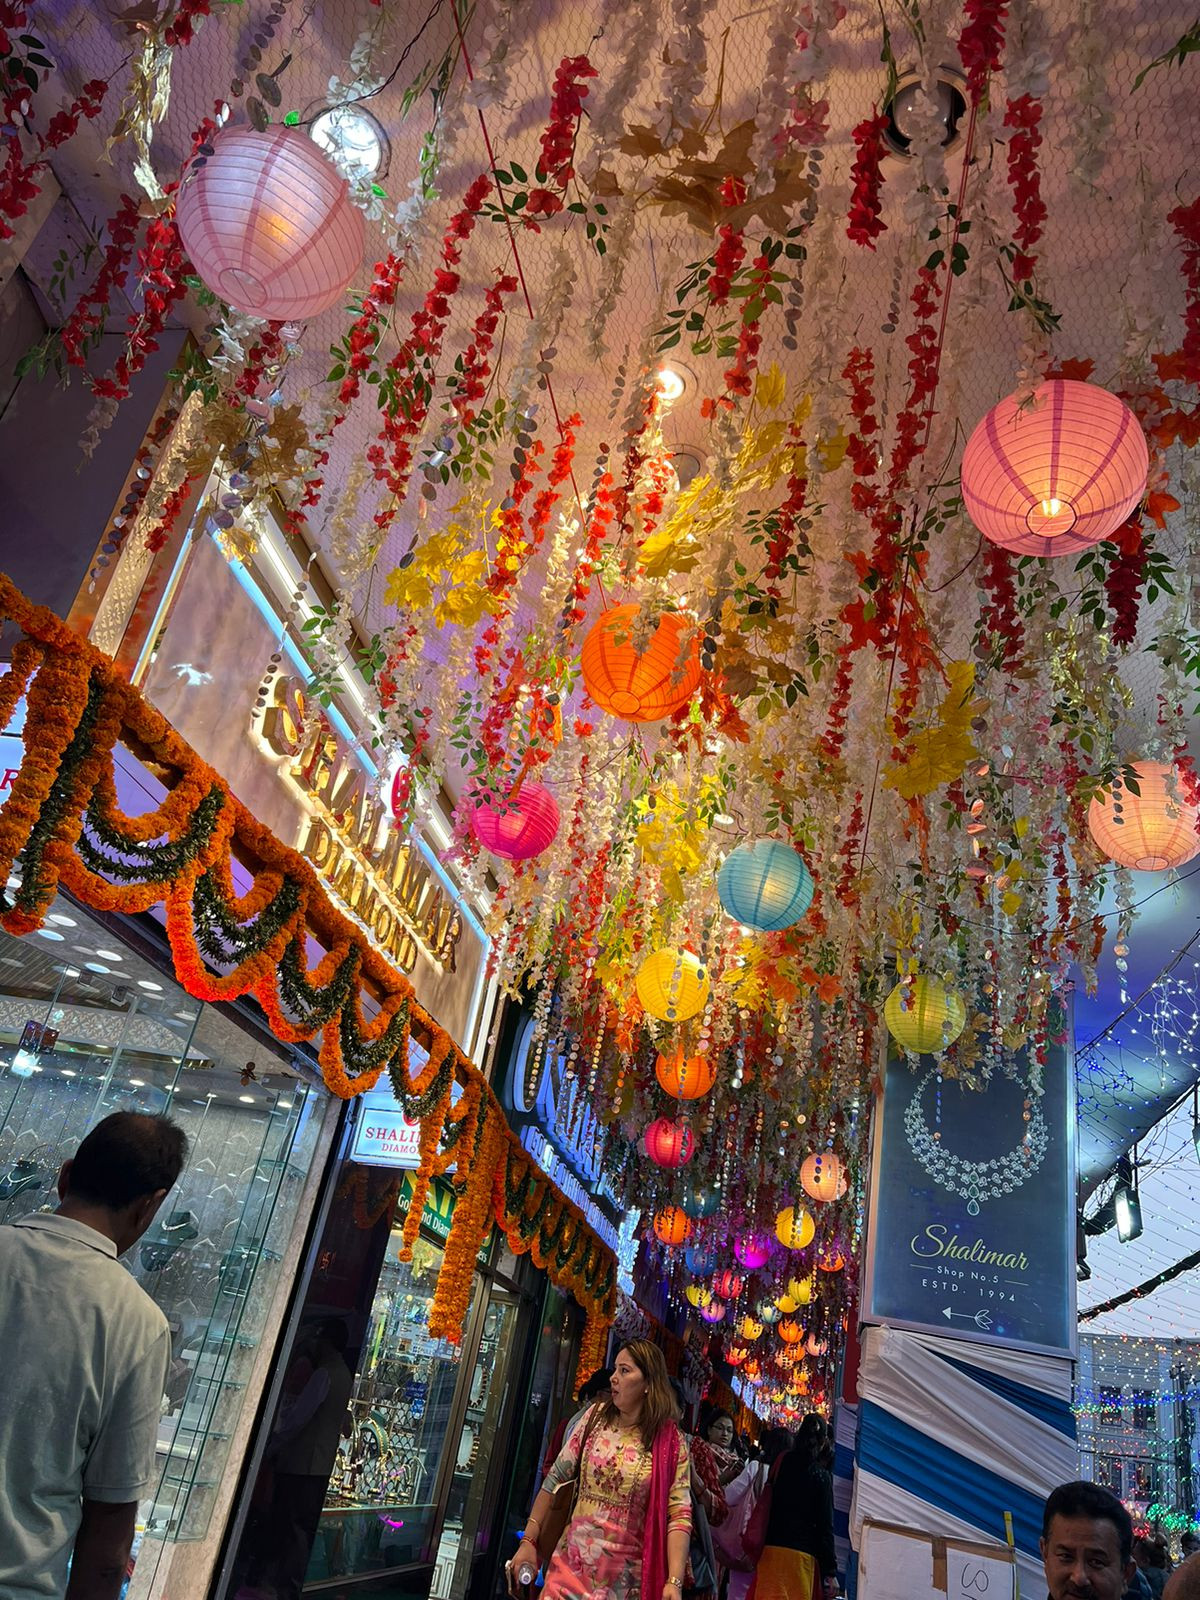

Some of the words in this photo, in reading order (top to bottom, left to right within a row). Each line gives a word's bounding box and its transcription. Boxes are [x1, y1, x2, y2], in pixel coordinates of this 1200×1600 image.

[365, 1127, 420, 1143] SHALI
[381, 1143, 420, 1154] DIAMO
[911, 1224, 1029, 1270] Shalimar
[937, 1265, 965, 1279] Shop
[922, 1278, 967, 1294] ESTD.
[979, 1288, 1016, 1302] 1994
